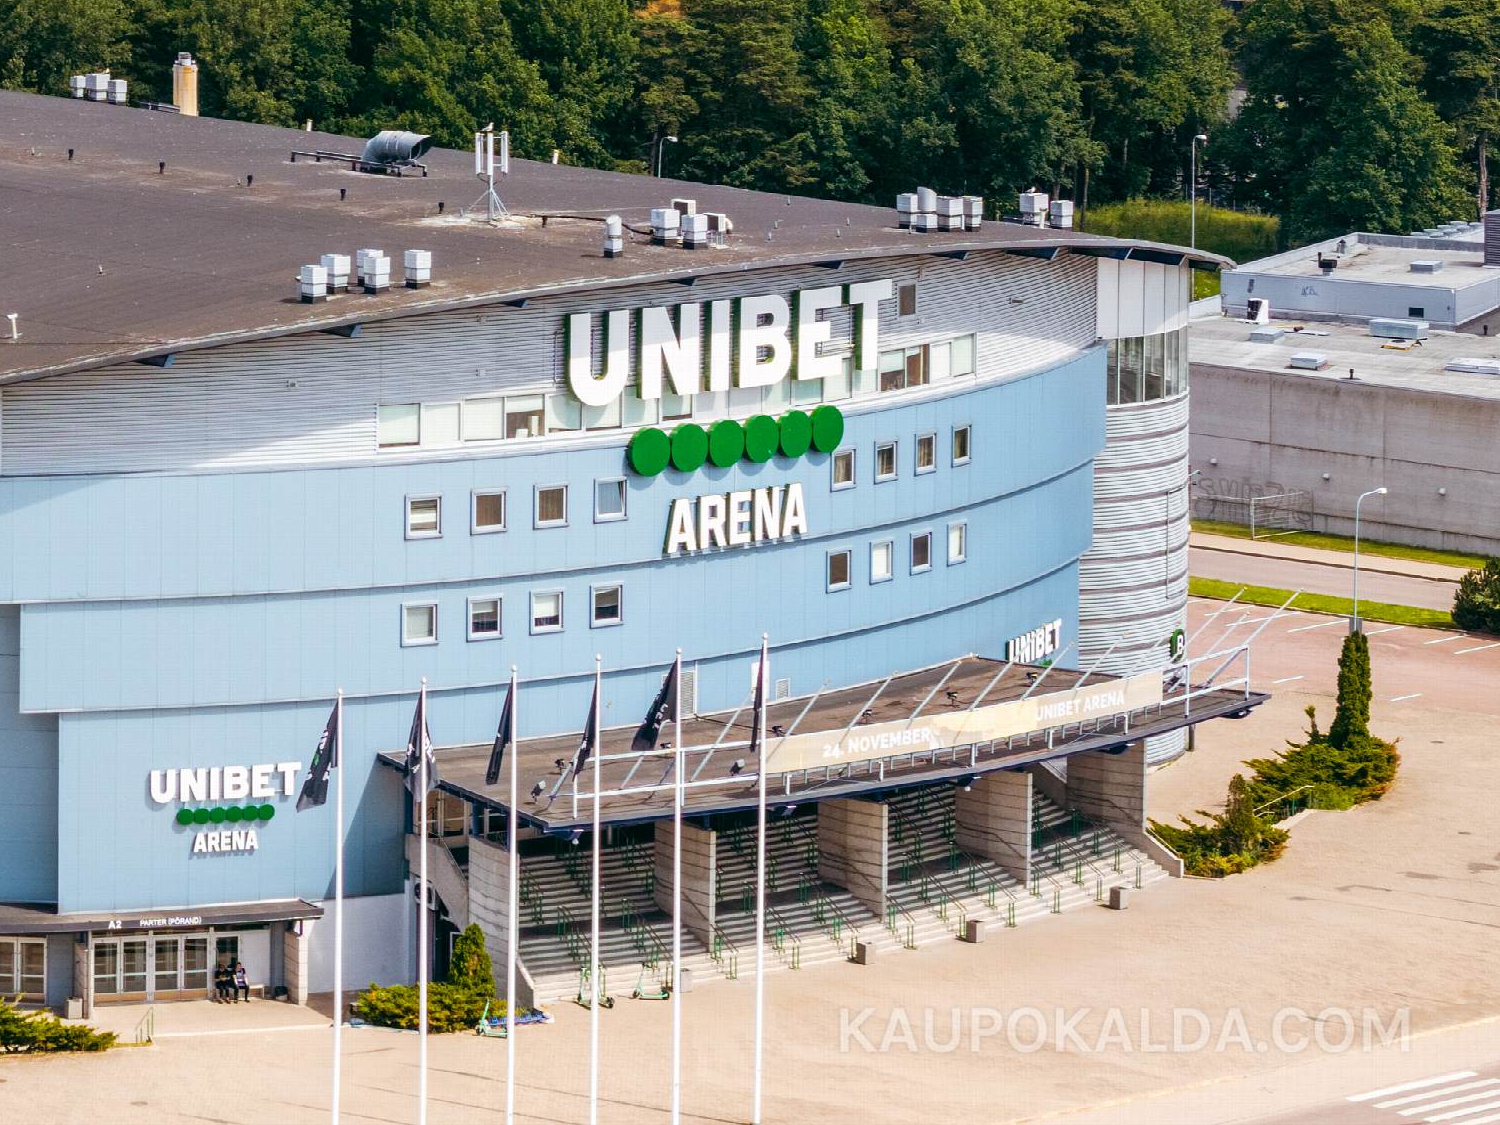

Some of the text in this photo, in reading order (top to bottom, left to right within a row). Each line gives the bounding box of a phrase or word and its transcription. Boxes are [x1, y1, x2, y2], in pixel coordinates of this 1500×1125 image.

[566, 278, 893, 407] UNIBET
[665, 482, 808, 555] ARENA
[1007, 618, 1062, 663] UNIBET
[1035, 689, 1126, 722] UNIBET ARENA
[847, 727, 931, 754] NOVEMBER
[150, 761, 302, 804] UNIBET
[193, 829, 260, 853] ARENA
[108, 920, 122, 929] A2
[139, 918, 167, 927] PARTER
